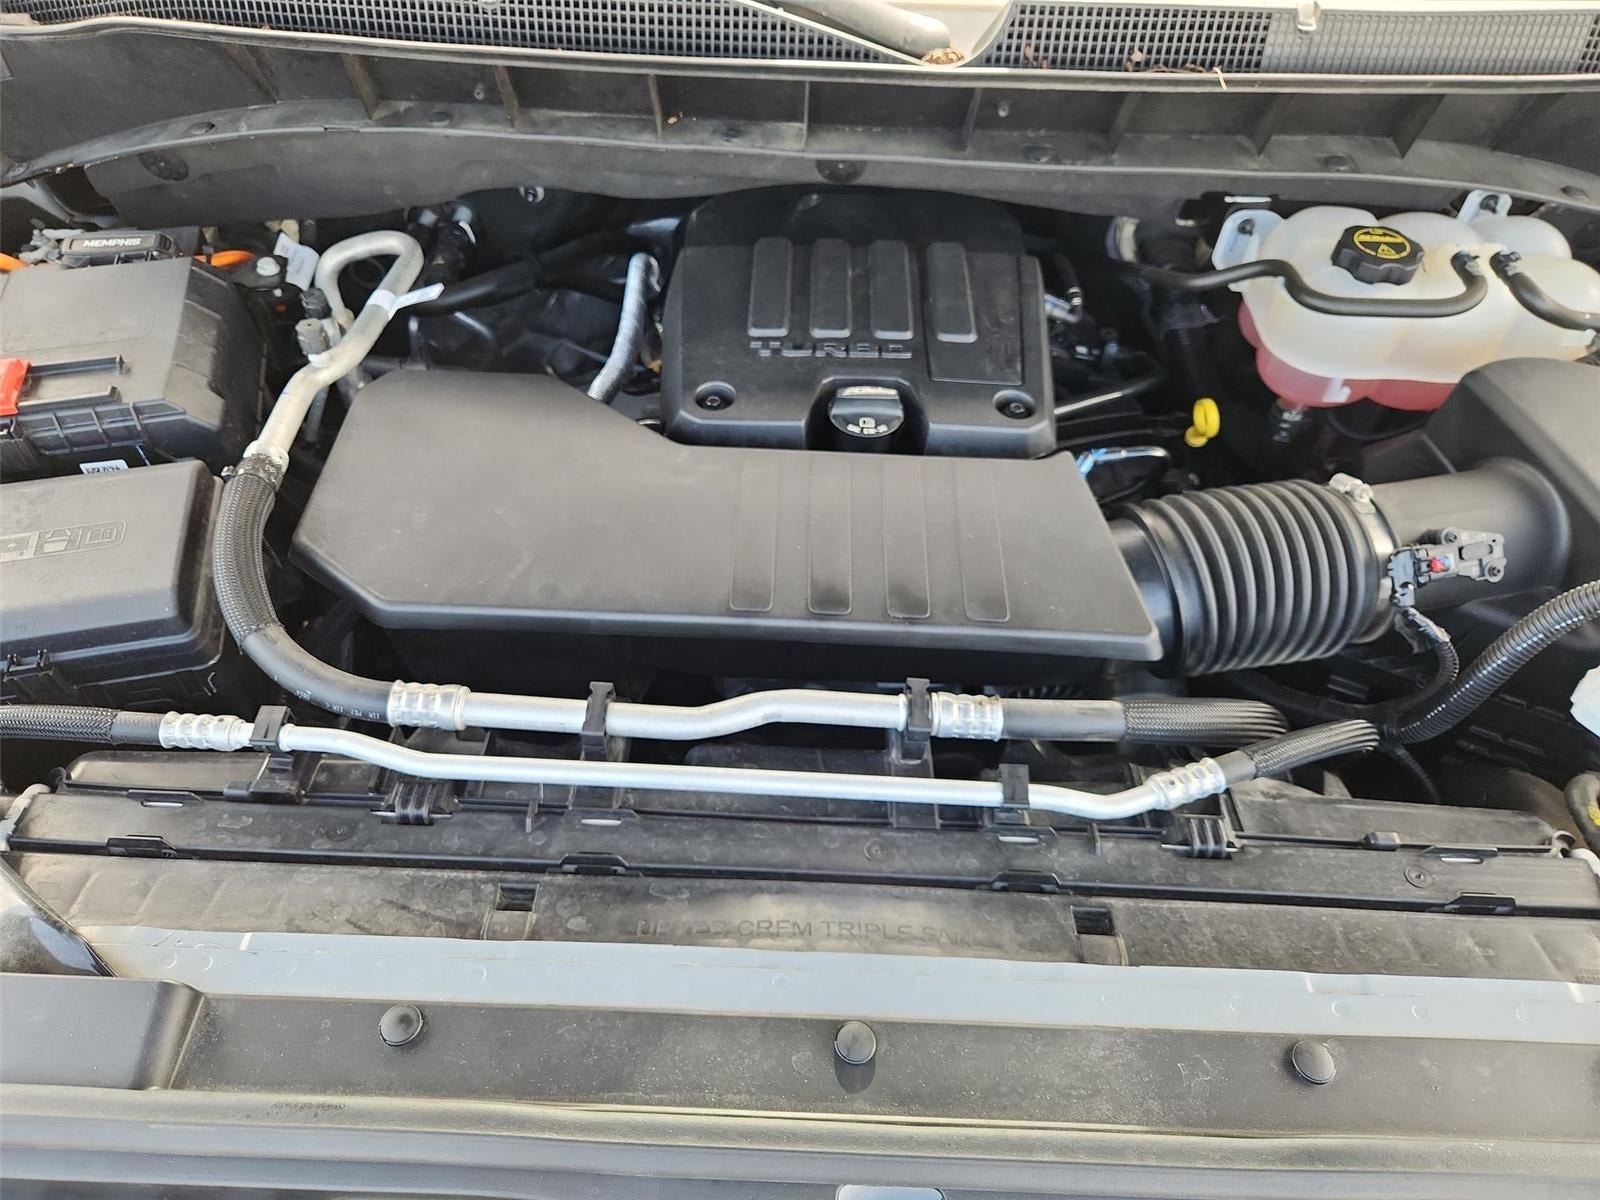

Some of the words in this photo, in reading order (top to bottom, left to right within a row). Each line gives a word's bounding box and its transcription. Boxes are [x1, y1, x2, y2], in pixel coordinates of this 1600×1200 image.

[83, 237, 142, 248] MEMPHIS
[750, 341, 912, 360] TURBO
[820, 920, 914, 941] TRIPLE
